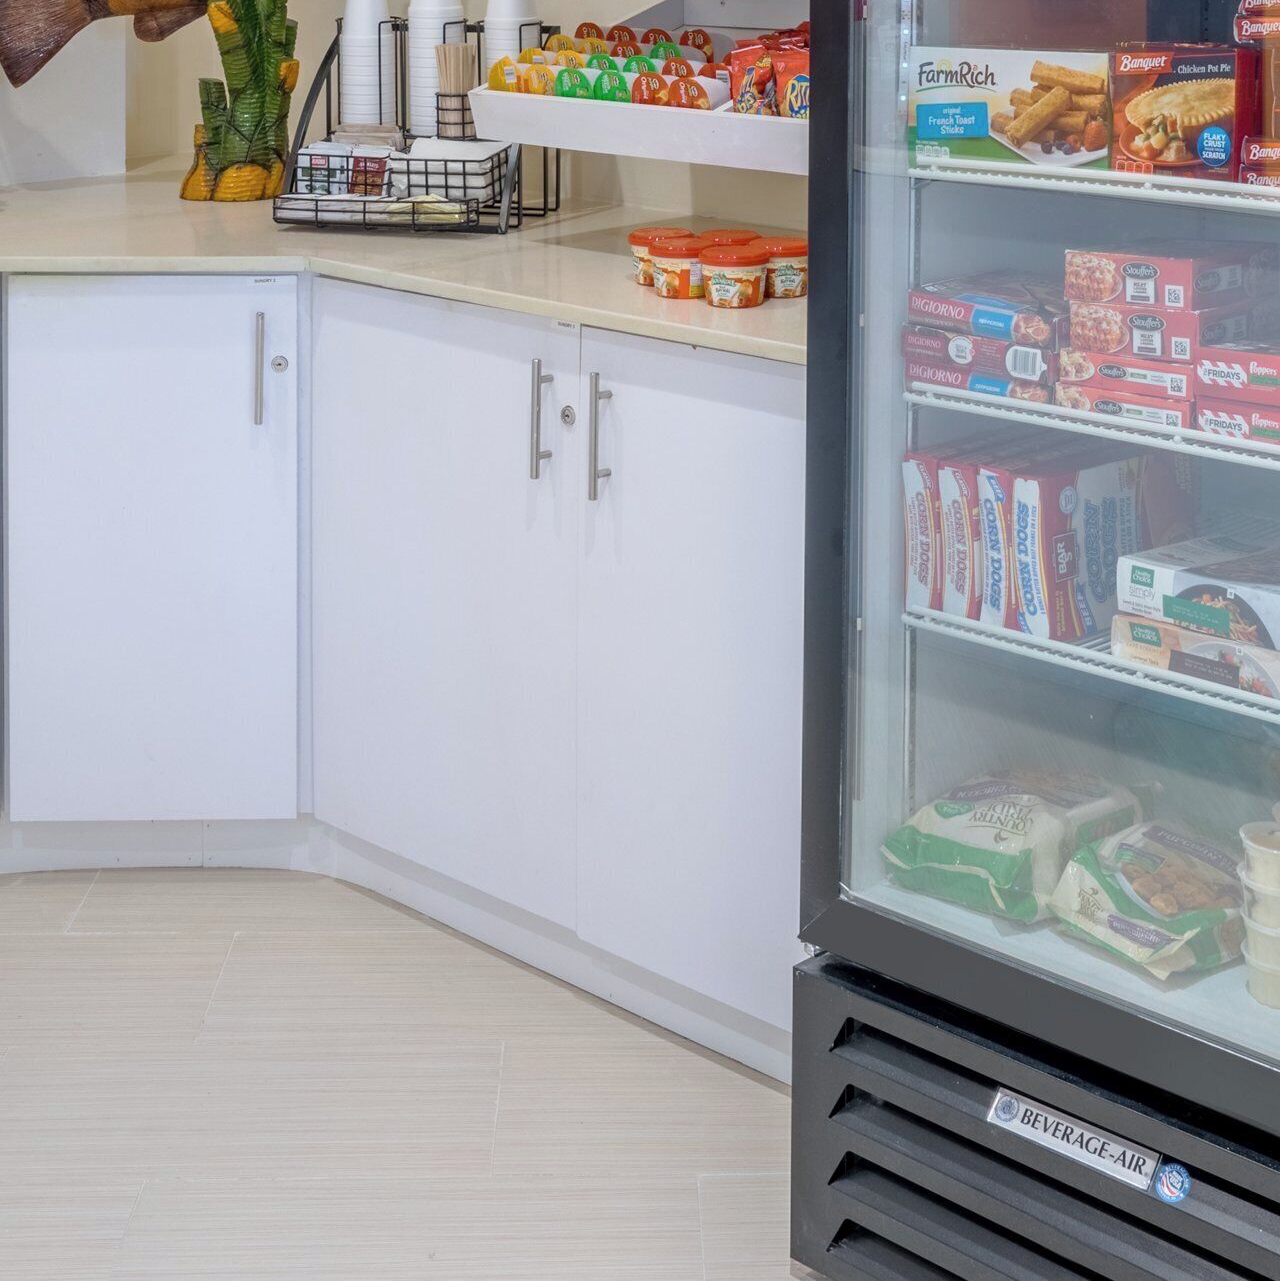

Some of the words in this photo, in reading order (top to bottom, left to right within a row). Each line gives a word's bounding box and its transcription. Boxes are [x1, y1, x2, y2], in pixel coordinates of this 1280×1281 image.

[1119, 54, 1168, 74] Banquet
[1177, 64, 1207, 75] Chicken
[1207, 63, 1220, 74] Pot
[1220, 63, 1232, 73] Pie
[928, 116, 953, 126] French
[954, 115, 975, 125] Toast
[940, 124, 965, 135] Sticks
[1203, 132, 1226, 141] FLAKY
[1203, 139, 1226, 148] CRUST
[1201, 150, 1226, 161] SCRATCH
[1124, 264, 1157, 279] Stouffer's
[1131, 316, 1163, 330] Stouffer's
[1100, 366, 1127, 378] Stouffer's
[1207, 369, 1241, 381] FRIDAYS
[1249, 361, 1278, 376] Poppers
[1096, 401, 1122, 414] Stouffer's
[1209, 419, 1243, 432] FRIDAYS
[1251, 413, 1280, 429] Poppers
[983, 497, 1001, 555] CORN
[988, 555, 1003, 613] DOGS
[1019, 1107, 1147, 1176] BEVERAGE-AIR
